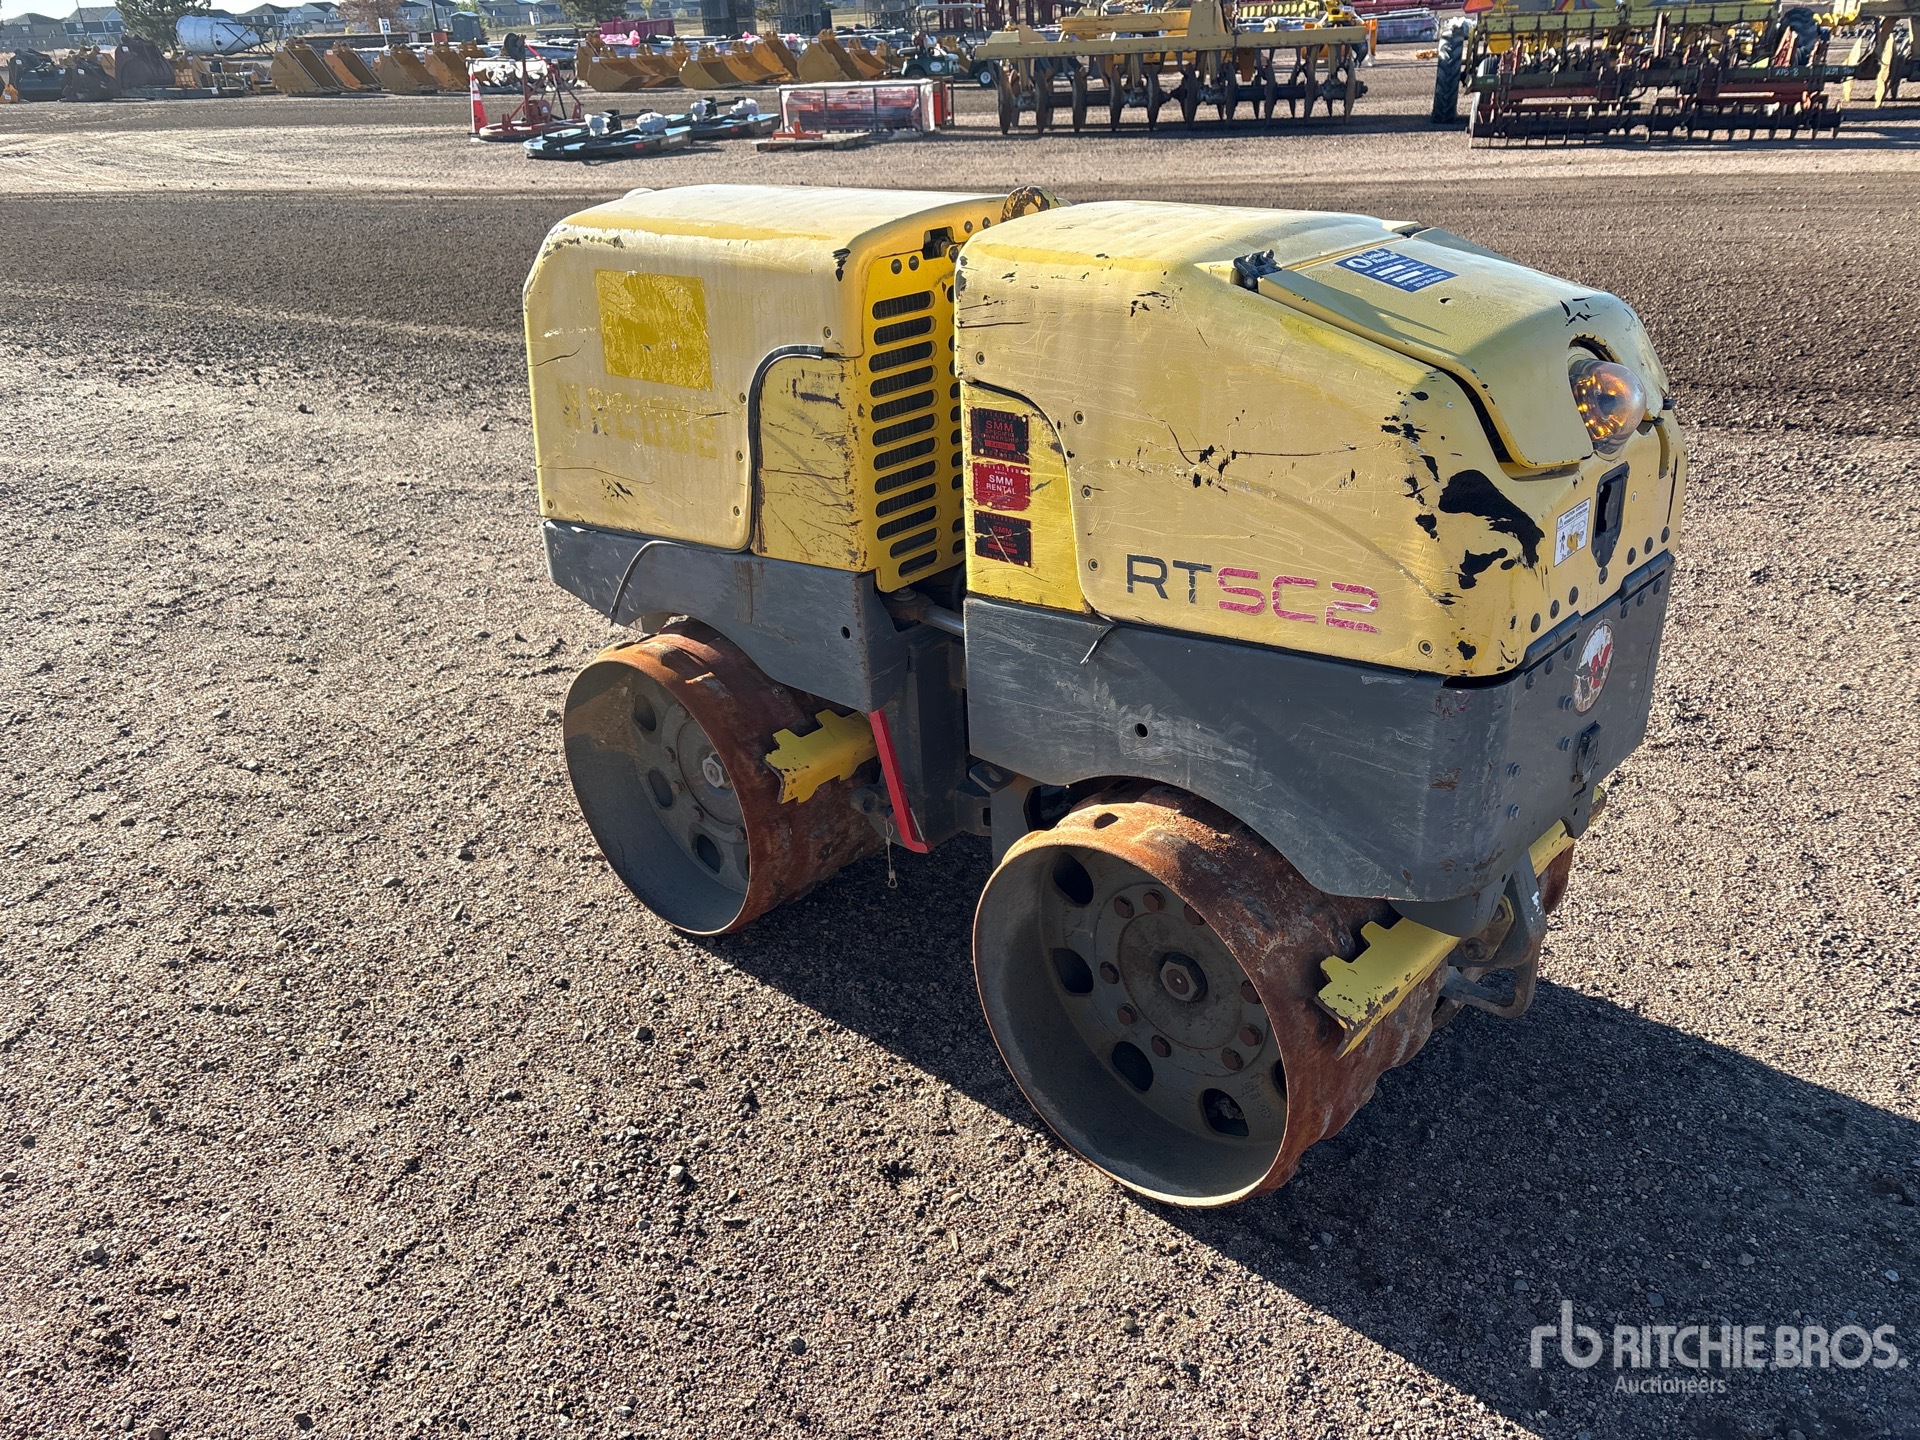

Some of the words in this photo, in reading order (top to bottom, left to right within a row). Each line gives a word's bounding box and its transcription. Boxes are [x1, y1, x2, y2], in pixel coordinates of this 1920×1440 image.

[985, 420, 1014, 432] SMM
[988, 474, 1014, 486] SMM
[986, 483, 1017, 495] RENTAL
[992, 526, 1013, 535] SMM
[1126, 553, 1380, 634] RTSC2
